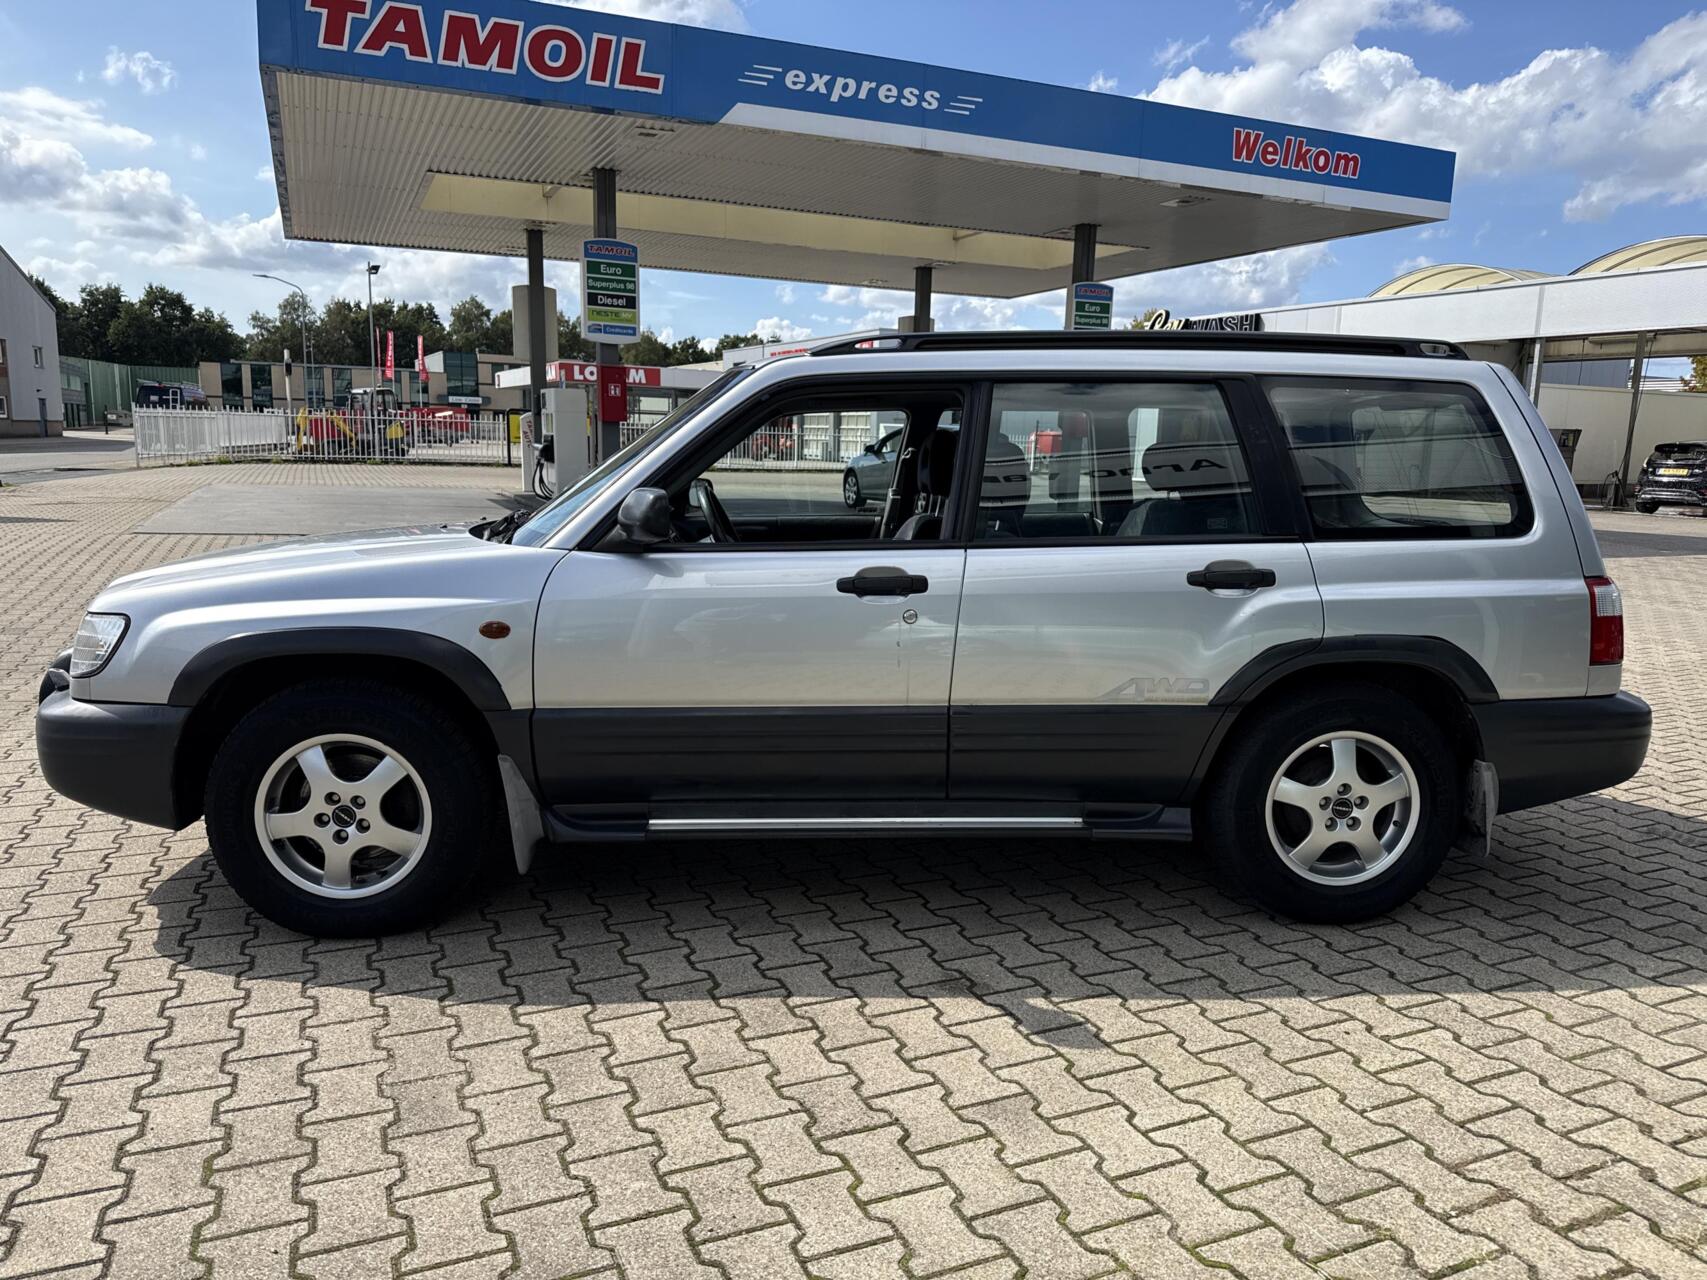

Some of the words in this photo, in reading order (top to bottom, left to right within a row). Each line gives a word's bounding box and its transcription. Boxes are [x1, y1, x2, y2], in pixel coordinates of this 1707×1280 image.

[305, 0, 665, 95] TAMOIL
[785, 69, 941, 110] express
[1233, 127, 1361, 179] Welkom
[588, 245, 634, 256] TAMOIL
[600, 264, 622, 275] Euro
[588, 278, 625, 289] Superplus
[597, 295, 627, 306] Diesel
[1084, 303, 1101, 312] Euro
[573, 365, 646, 384] LOM
[1094, 677, 1210, 702] AWD
